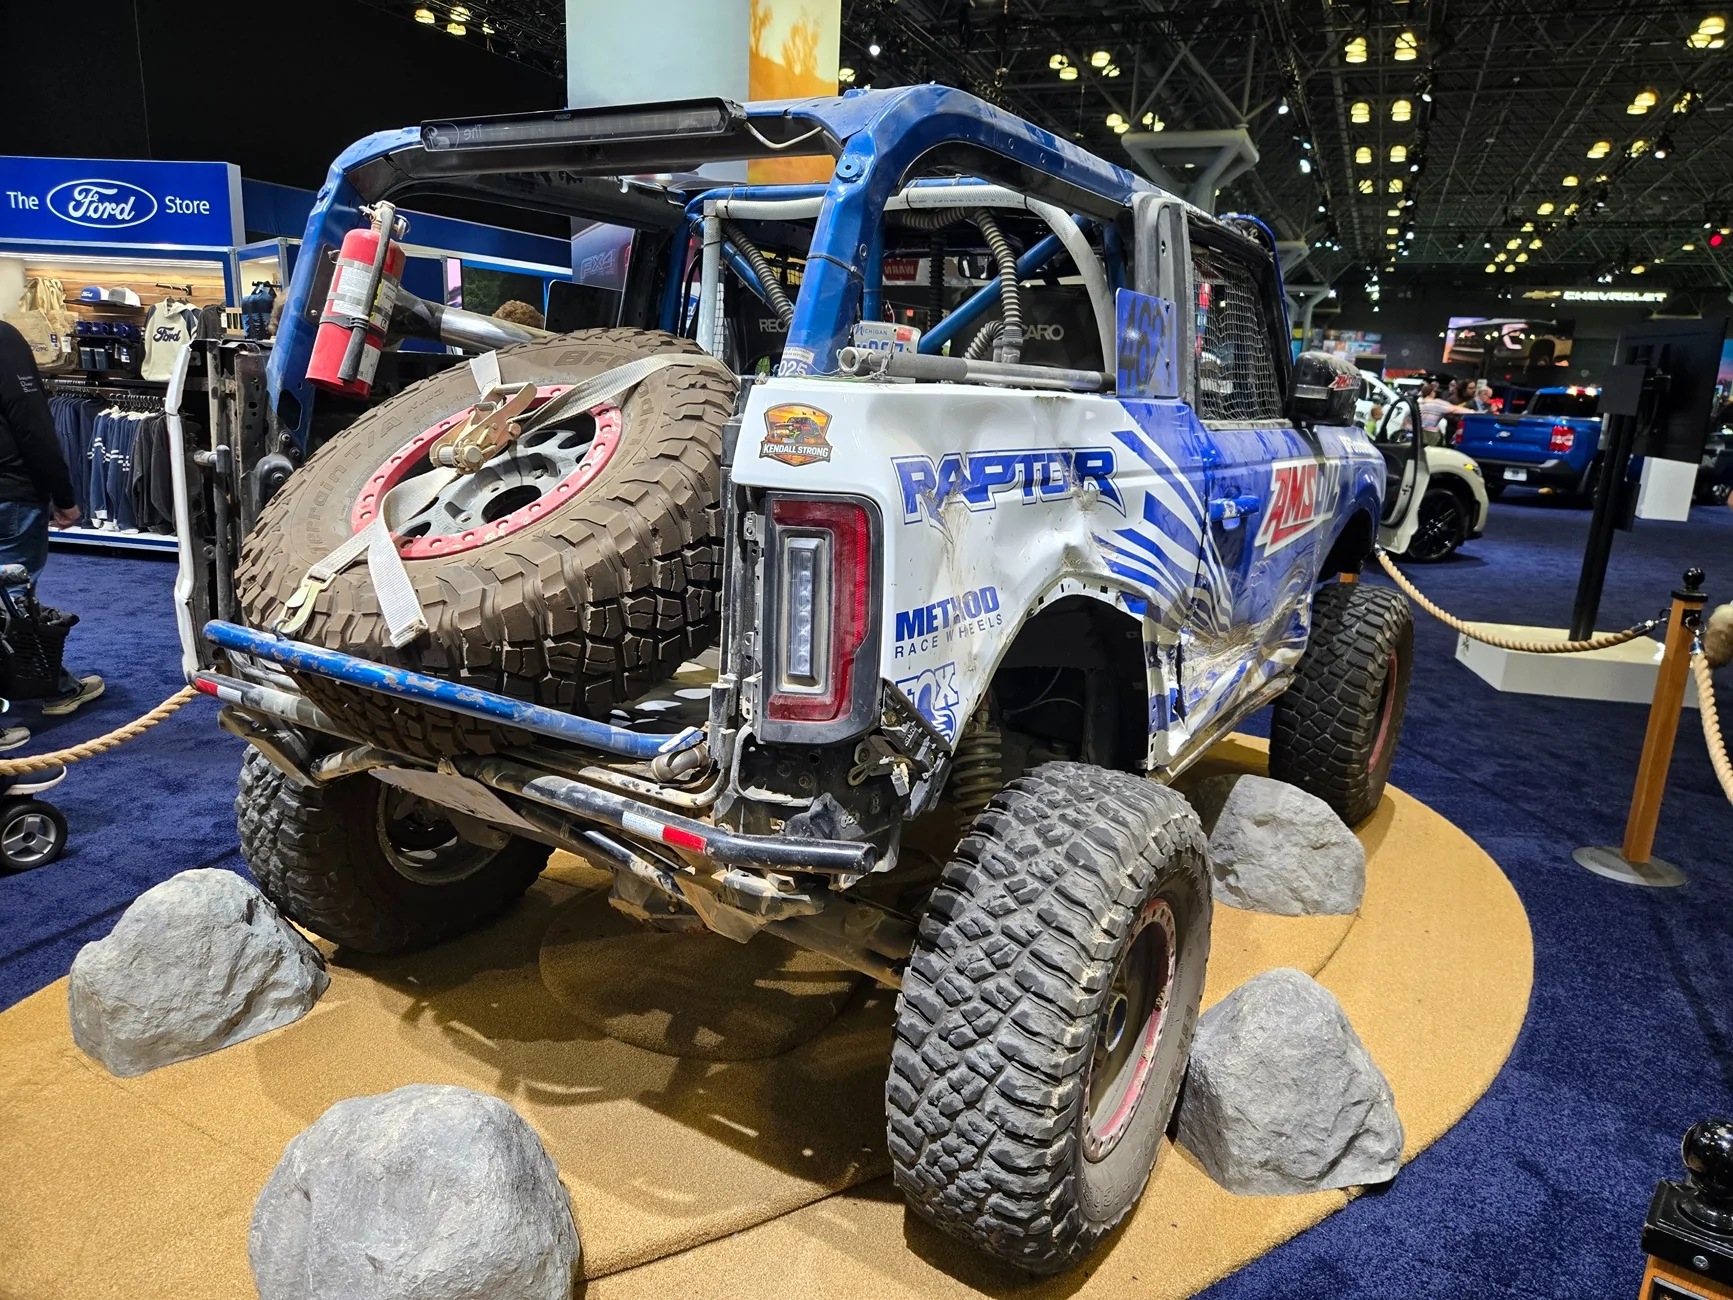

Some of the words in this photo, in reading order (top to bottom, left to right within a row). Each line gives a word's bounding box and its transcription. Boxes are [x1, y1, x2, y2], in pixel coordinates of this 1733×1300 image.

[6, 191, 39, 209] The
[68, 185, 135, 220] Ford
[165, 196, 210, 214] Store
[1563, 290, 1667, 302] CHEVROLET
[153, 326, 181, 342] Ford
[759, 318, 788, 333] REC
[763, 443, 797, 454] KENDALL
[797, 447, 829, 457] STRONG
[890, 446, 1126, 546] RAPTOR
[895, 585, 1000, 643] METHOD
[895, 637, 940, 660] RACE
[945, 613, 1004, 643] WHEELS
